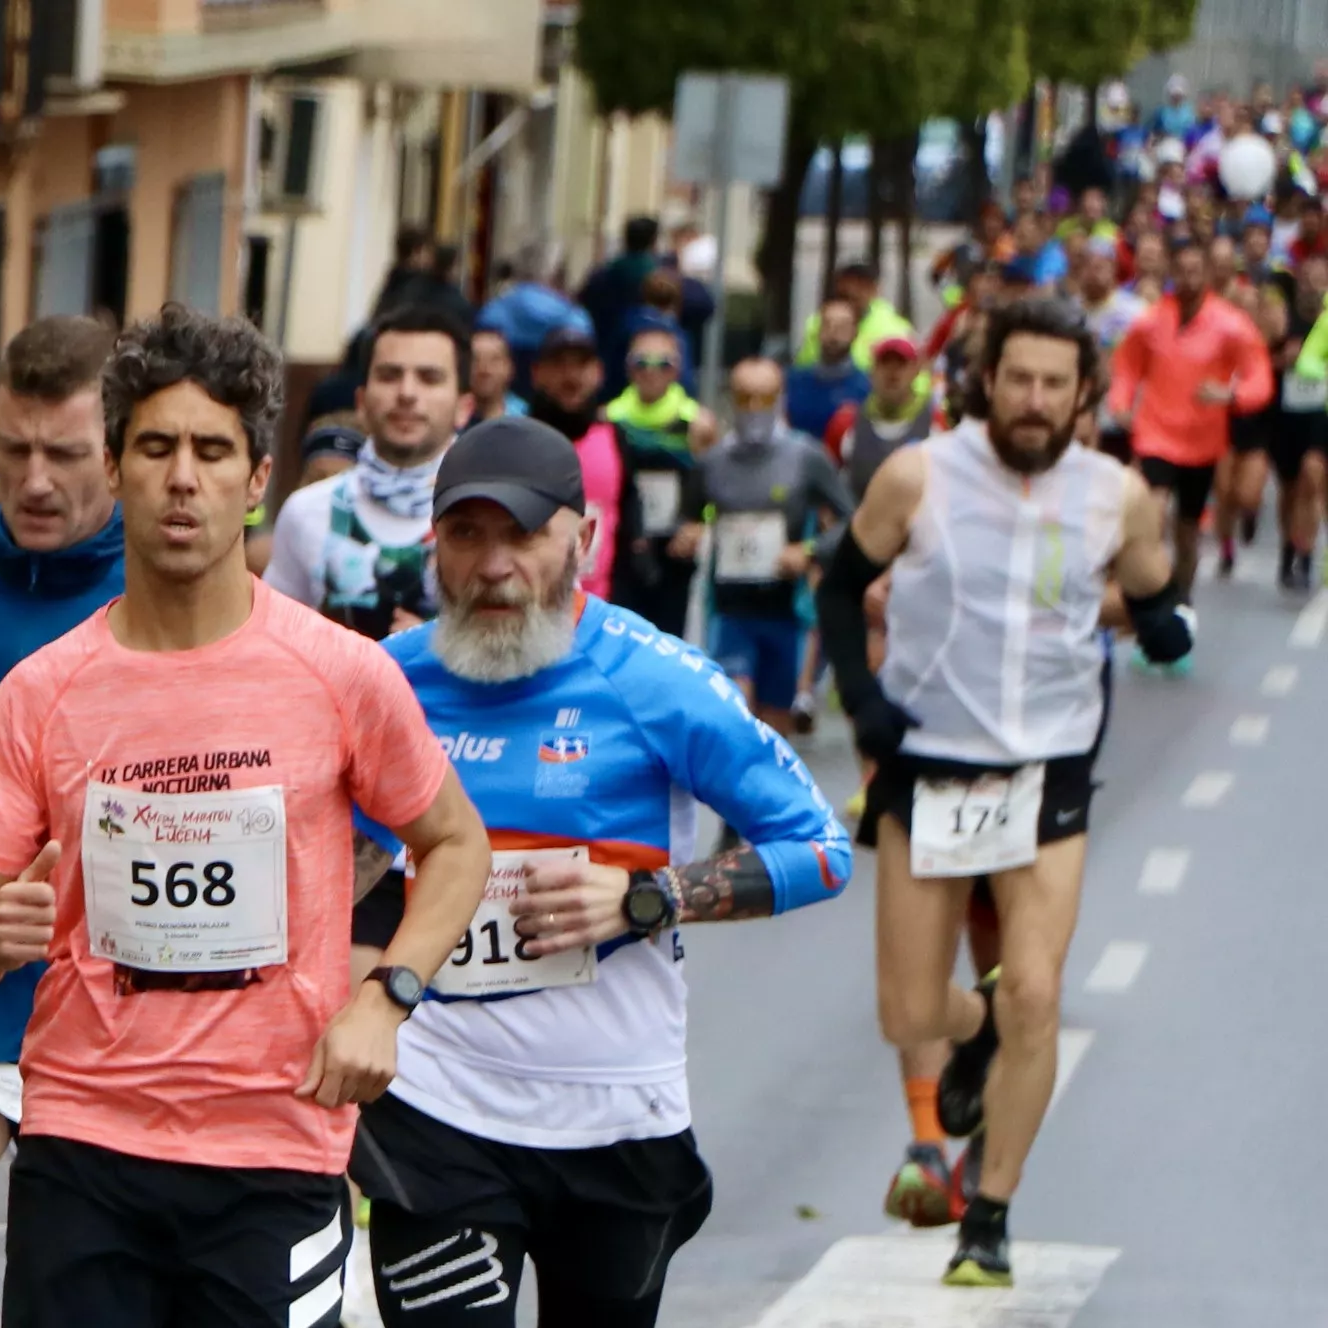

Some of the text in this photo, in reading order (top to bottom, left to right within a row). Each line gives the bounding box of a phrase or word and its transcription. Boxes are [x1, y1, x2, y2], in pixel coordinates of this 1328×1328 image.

[101, 749, 272, 784] IX CARRERA URBANA
[142, 773, 231, 794] NOCTURNA
[155, 826, 221, 844] LUCENA
[131, 860, 236, 908] 568
